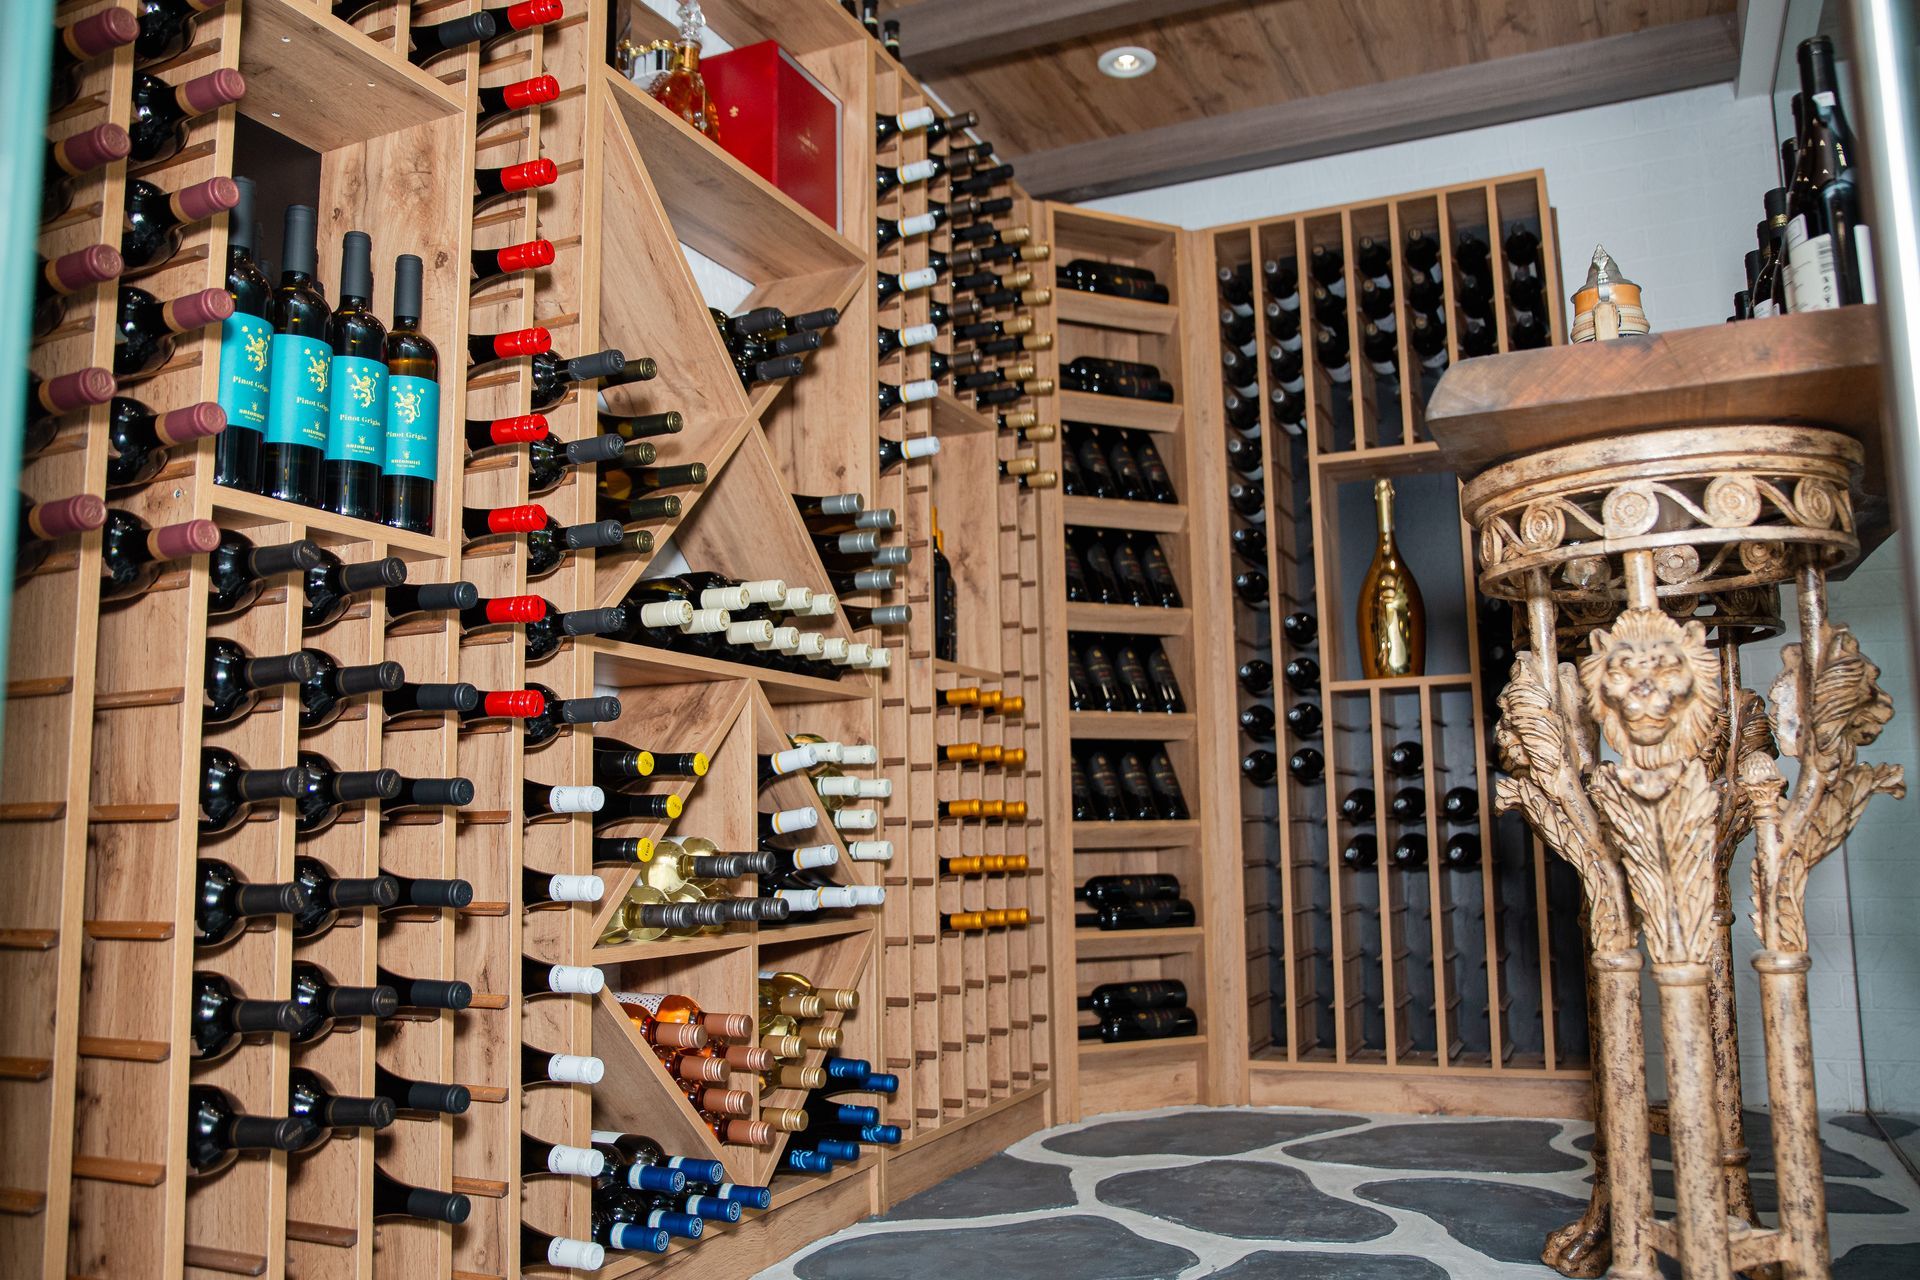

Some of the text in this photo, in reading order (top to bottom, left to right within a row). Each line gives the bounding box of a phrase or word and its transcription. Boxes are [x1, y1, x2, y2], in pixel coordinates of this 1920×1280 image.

[233, 375, 254, 386] Pinot
[296, 396, 316, 406] Pinot
[339, 414, 360, 422] Pinot
